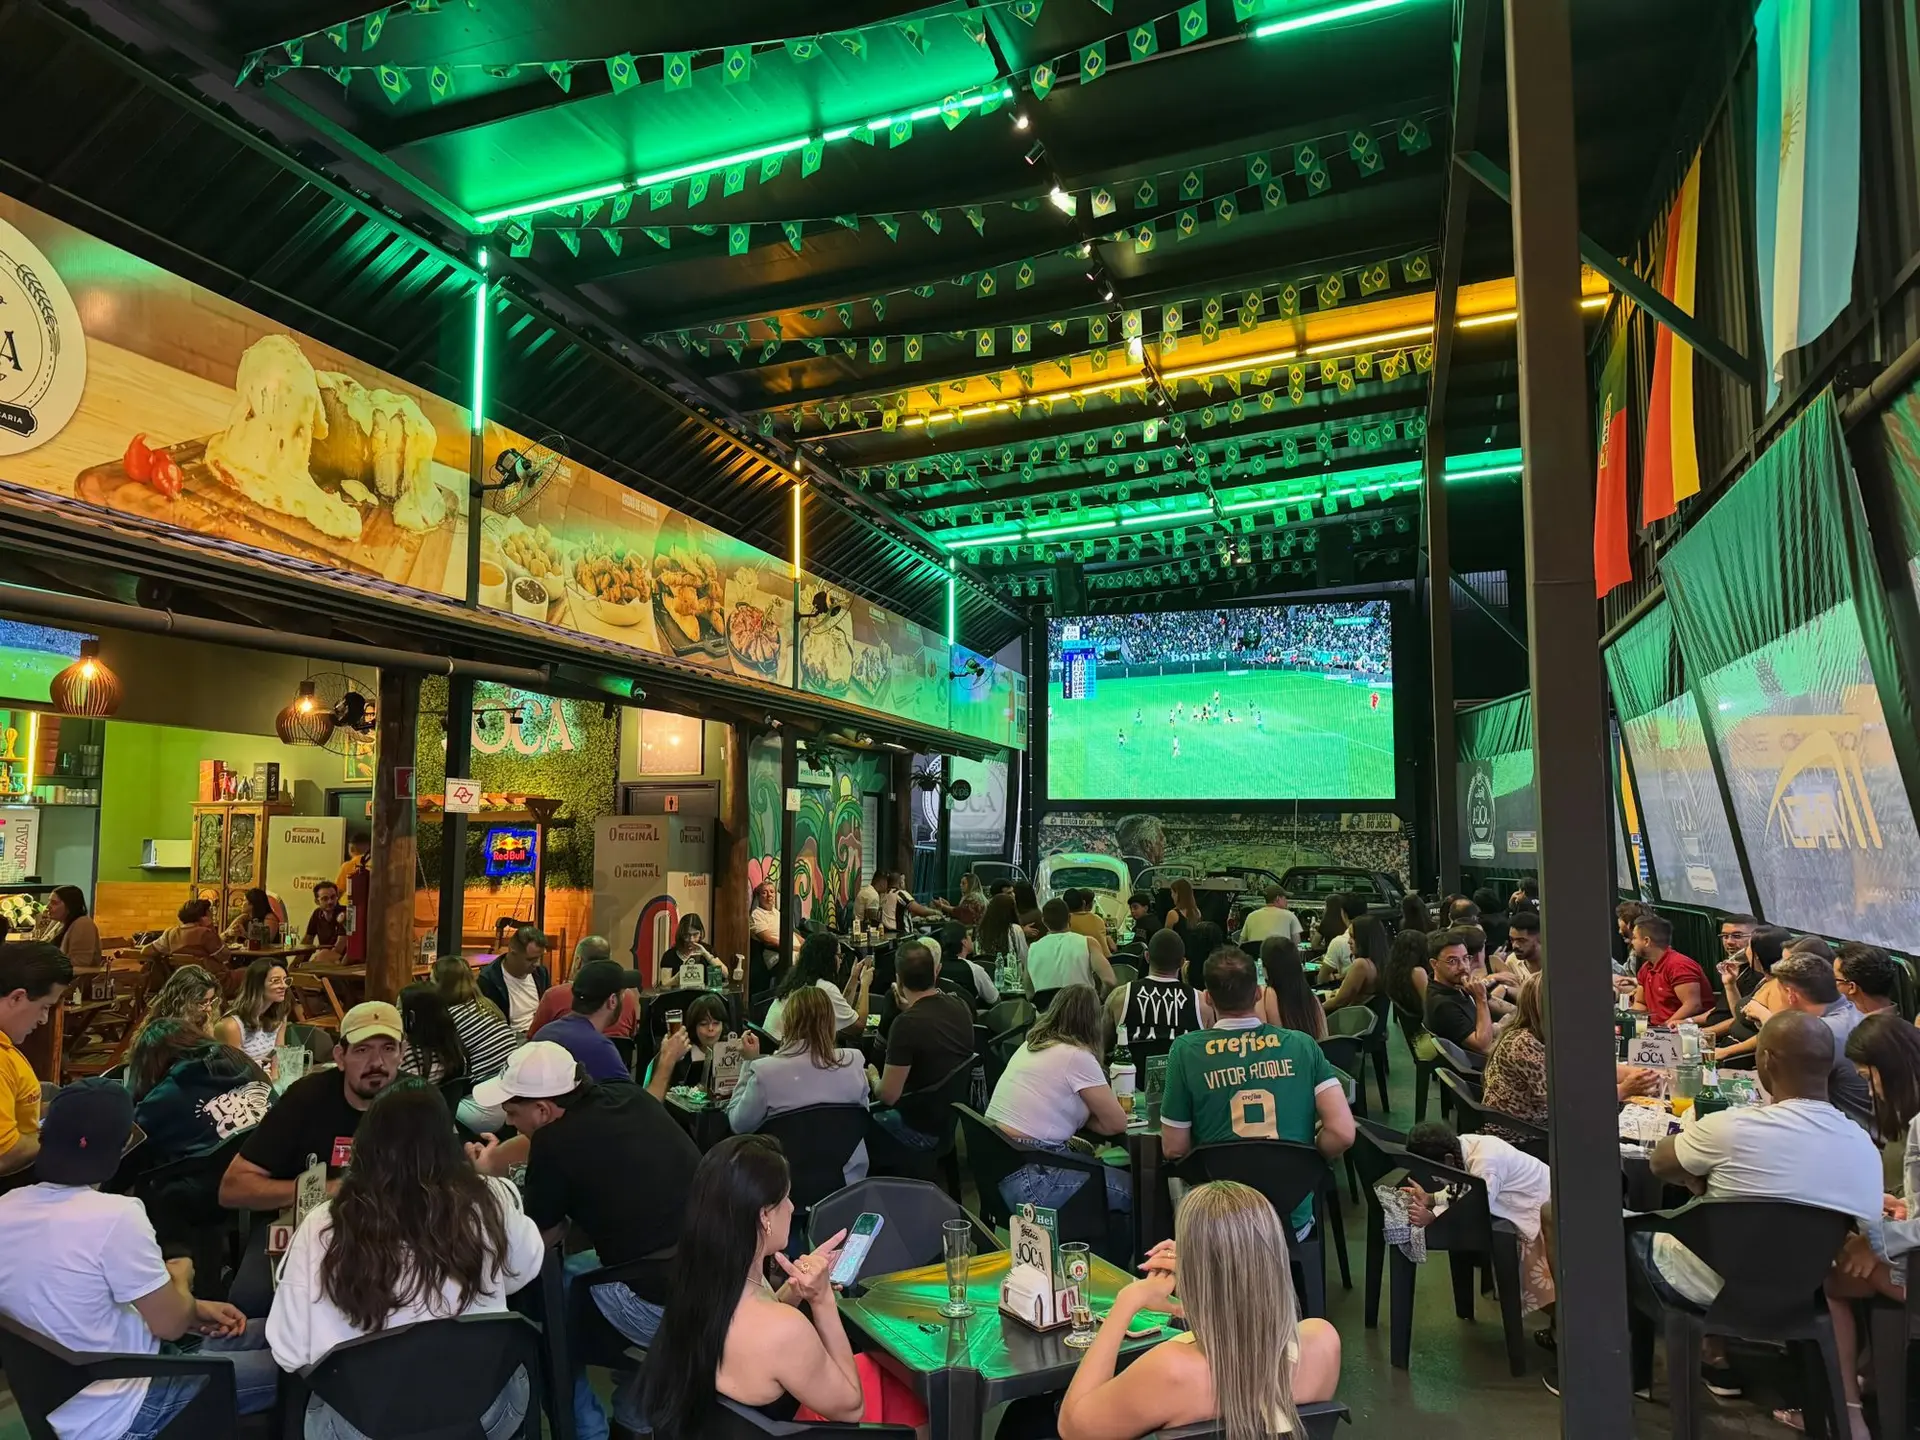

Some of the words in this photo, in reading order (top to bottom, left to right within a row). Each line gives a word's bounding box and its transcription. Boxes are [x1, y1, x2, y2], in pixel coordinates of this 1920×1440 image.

[441, 698, 576, 754] OCA
[284, 830, 326, 845] ORIGINAL
[609, 827, 660, 842] ORIGINAL
[493, 849, 509, 861] Red
[510, 849, 525, 860] Bull
[614, 864, 661, 879] ORIGINAL
[1137, 985, 1188, 1027] SCCP
[1205, 1031, 1281, 1058] crefisa
[1634, 1051, 1665, 1064] JOCA
[1204, 1067, 1247, 1090] VITOR
[1249, 1059, 1295, 1080] ROQUE
[1016, 1243, 1045, 1271] JOCA
